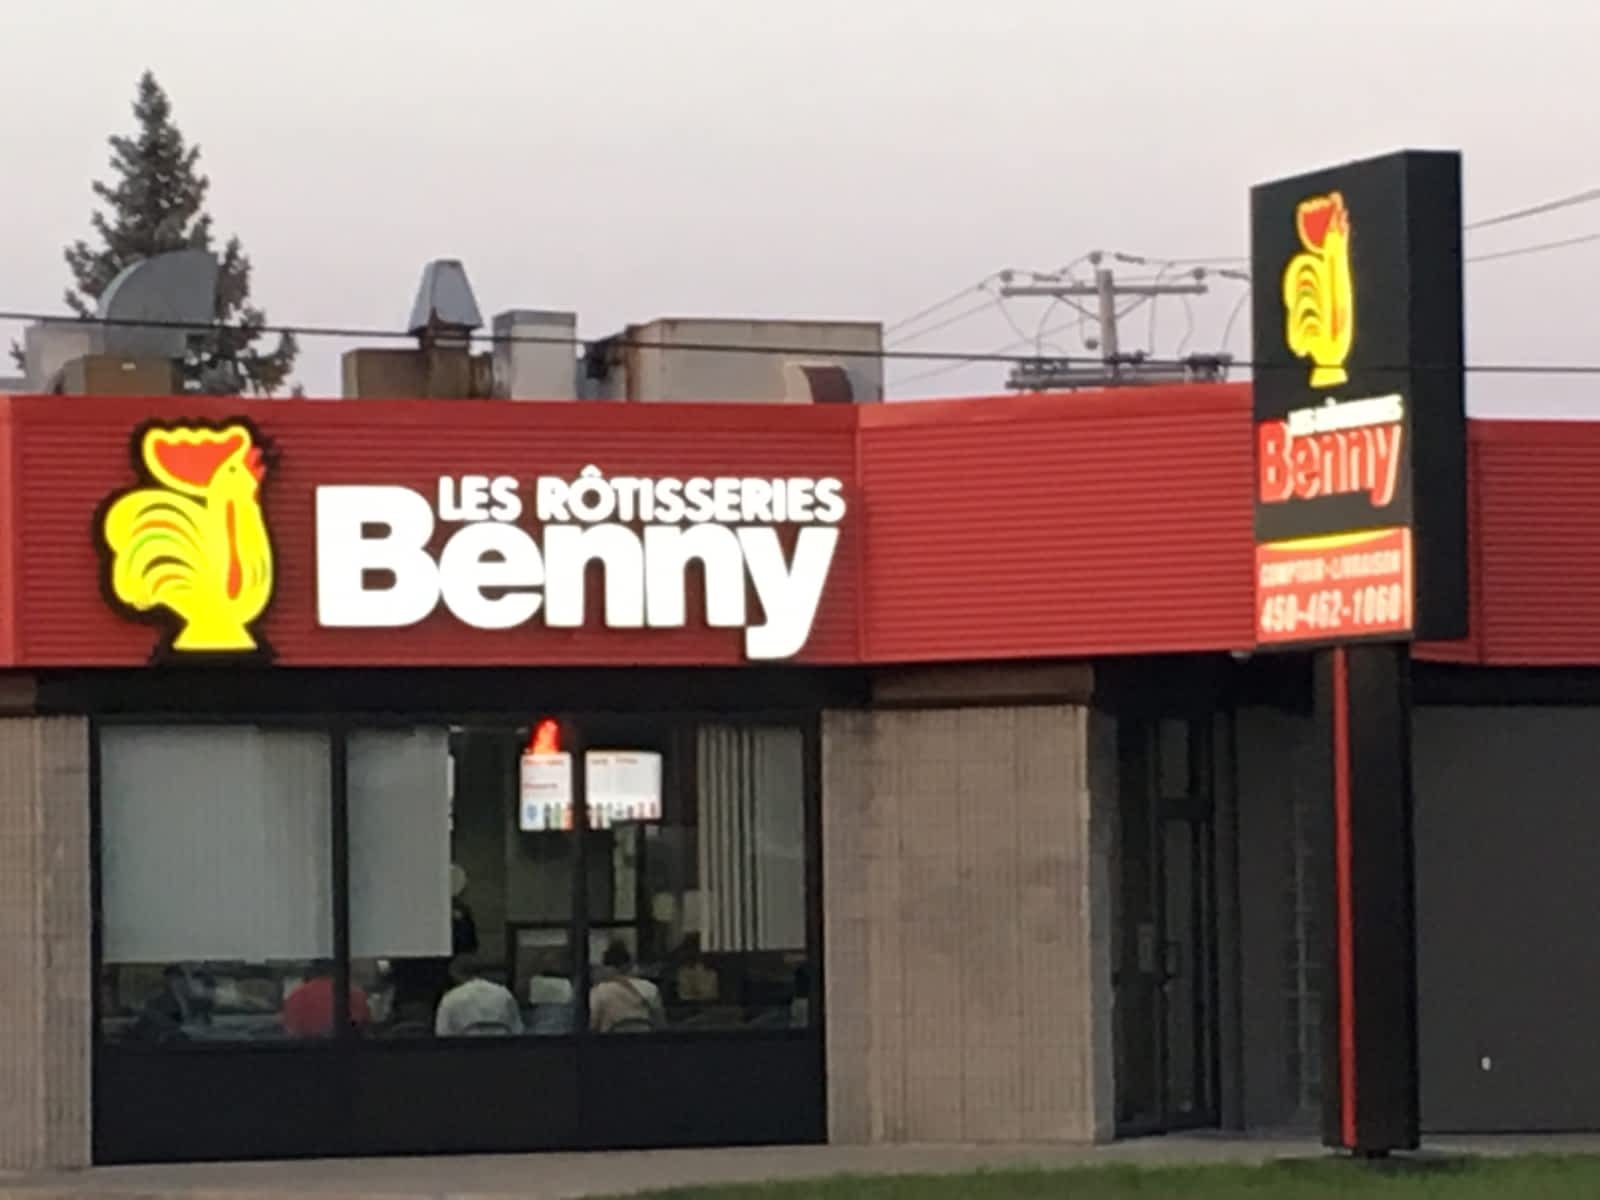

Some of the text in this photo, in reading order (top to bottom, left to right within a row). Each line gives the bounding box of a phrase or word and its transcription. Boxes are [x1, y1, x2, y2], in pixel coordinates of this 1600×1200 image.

[438, 464, 846, 523] LES RÔTISSERIES
[1259, 418, 1402, 507] Benny
[315, 485, 840, 660] Benny
